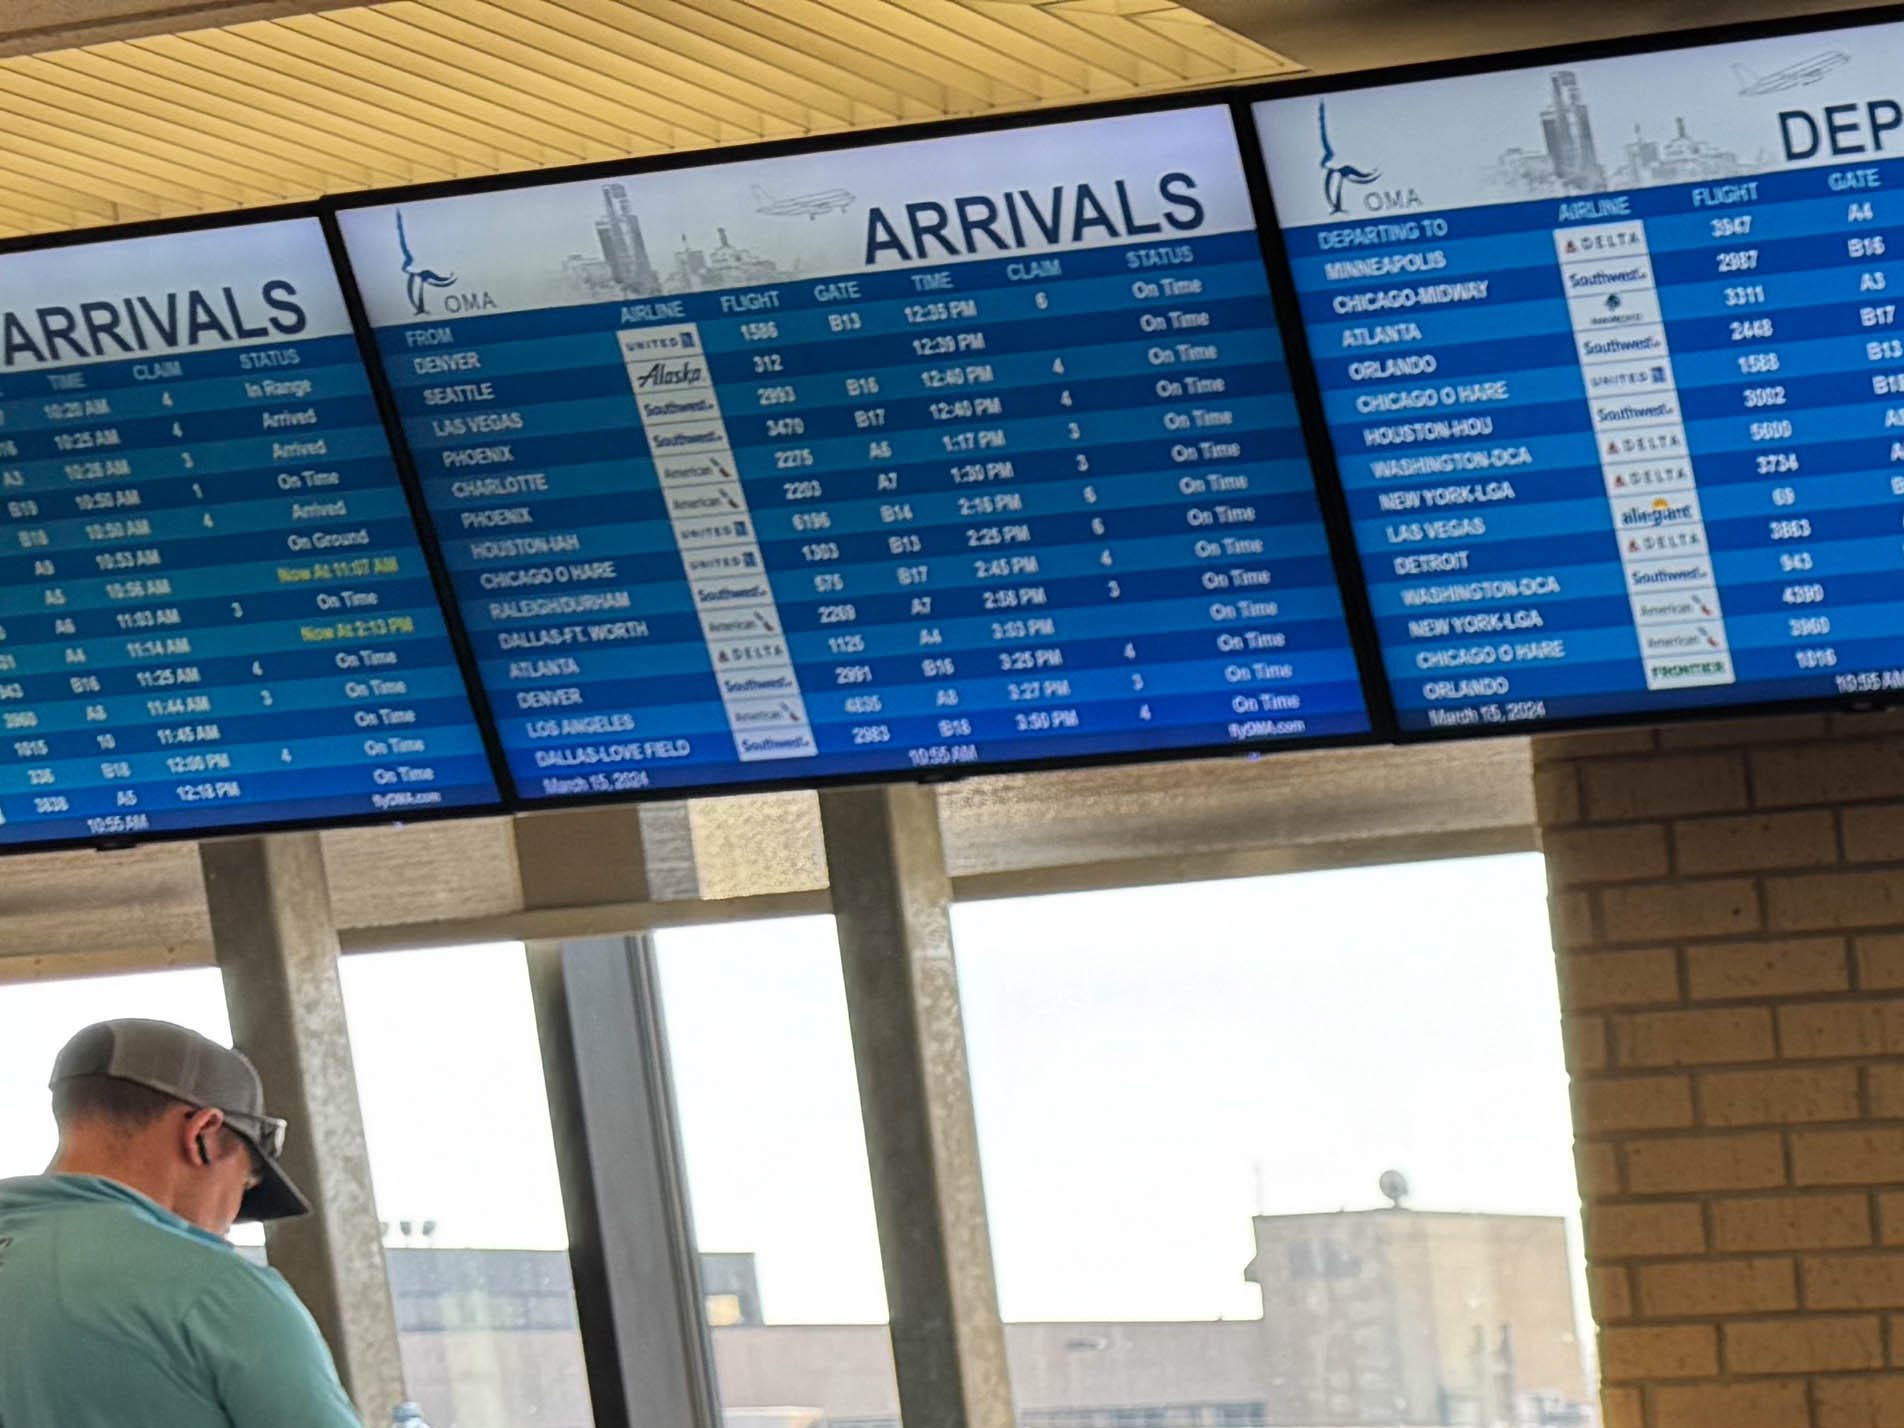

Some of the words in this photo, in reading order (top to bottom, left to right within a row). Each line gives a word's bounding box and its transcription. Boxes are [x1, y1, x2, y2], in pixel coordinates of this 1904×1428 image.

[1363, 187, 1422, 212] OMA
[865, 171, 1204, 266] ARRIVALS
[1324, 250, 1446, 280] MINNEAPOLIS
[444, 290, 497, 314] OMA
[2, 280, 307, 366] ARRIVALS
[1342, 322, 1422, 347] ATLANTA
[412, 351, 481, 374] DENVER
[1348, 353, 1437, 380] ORLANDO
[422, 381, 495, 405] SEATTLE
[263, 408, 317, 429] Arrived
[431, 418, 467, 437] LAS
[465, 411, 524, 432] VEGAS
[442, 445, 514, 467] PHOENIX
[450, 472, 549, 498] CHARLOTTE
[1393, 550, 1468, 575] DETROIT
